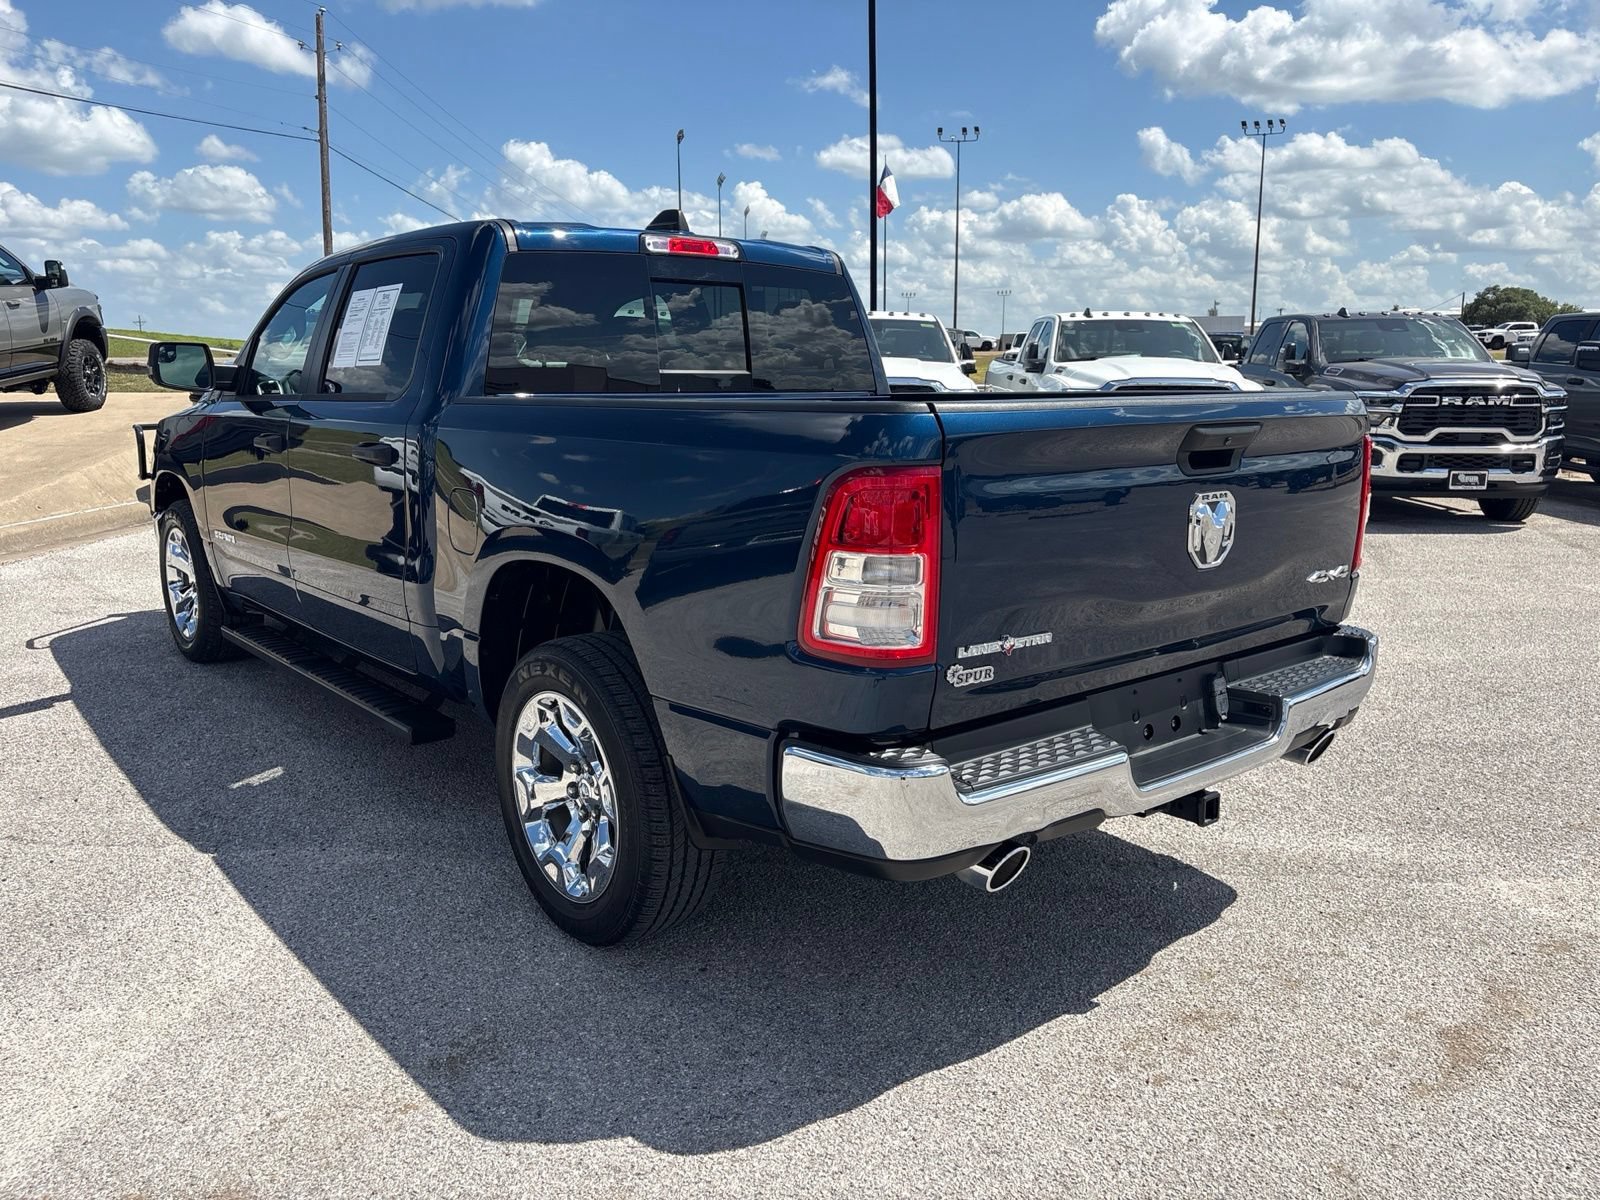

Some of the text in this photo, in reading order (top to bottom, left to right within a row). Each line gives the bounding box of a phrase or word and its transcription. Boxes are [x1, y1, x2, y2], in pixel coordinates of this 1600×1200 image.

[1441, 395, 1511, 406] RAM
[1202, 492, 1228, 501] RAM
[957, 632, 1053, 659] LONE STAR
[516, 661, 589, 706] NEXEN
[956, 667, 992, 684] SPUR
